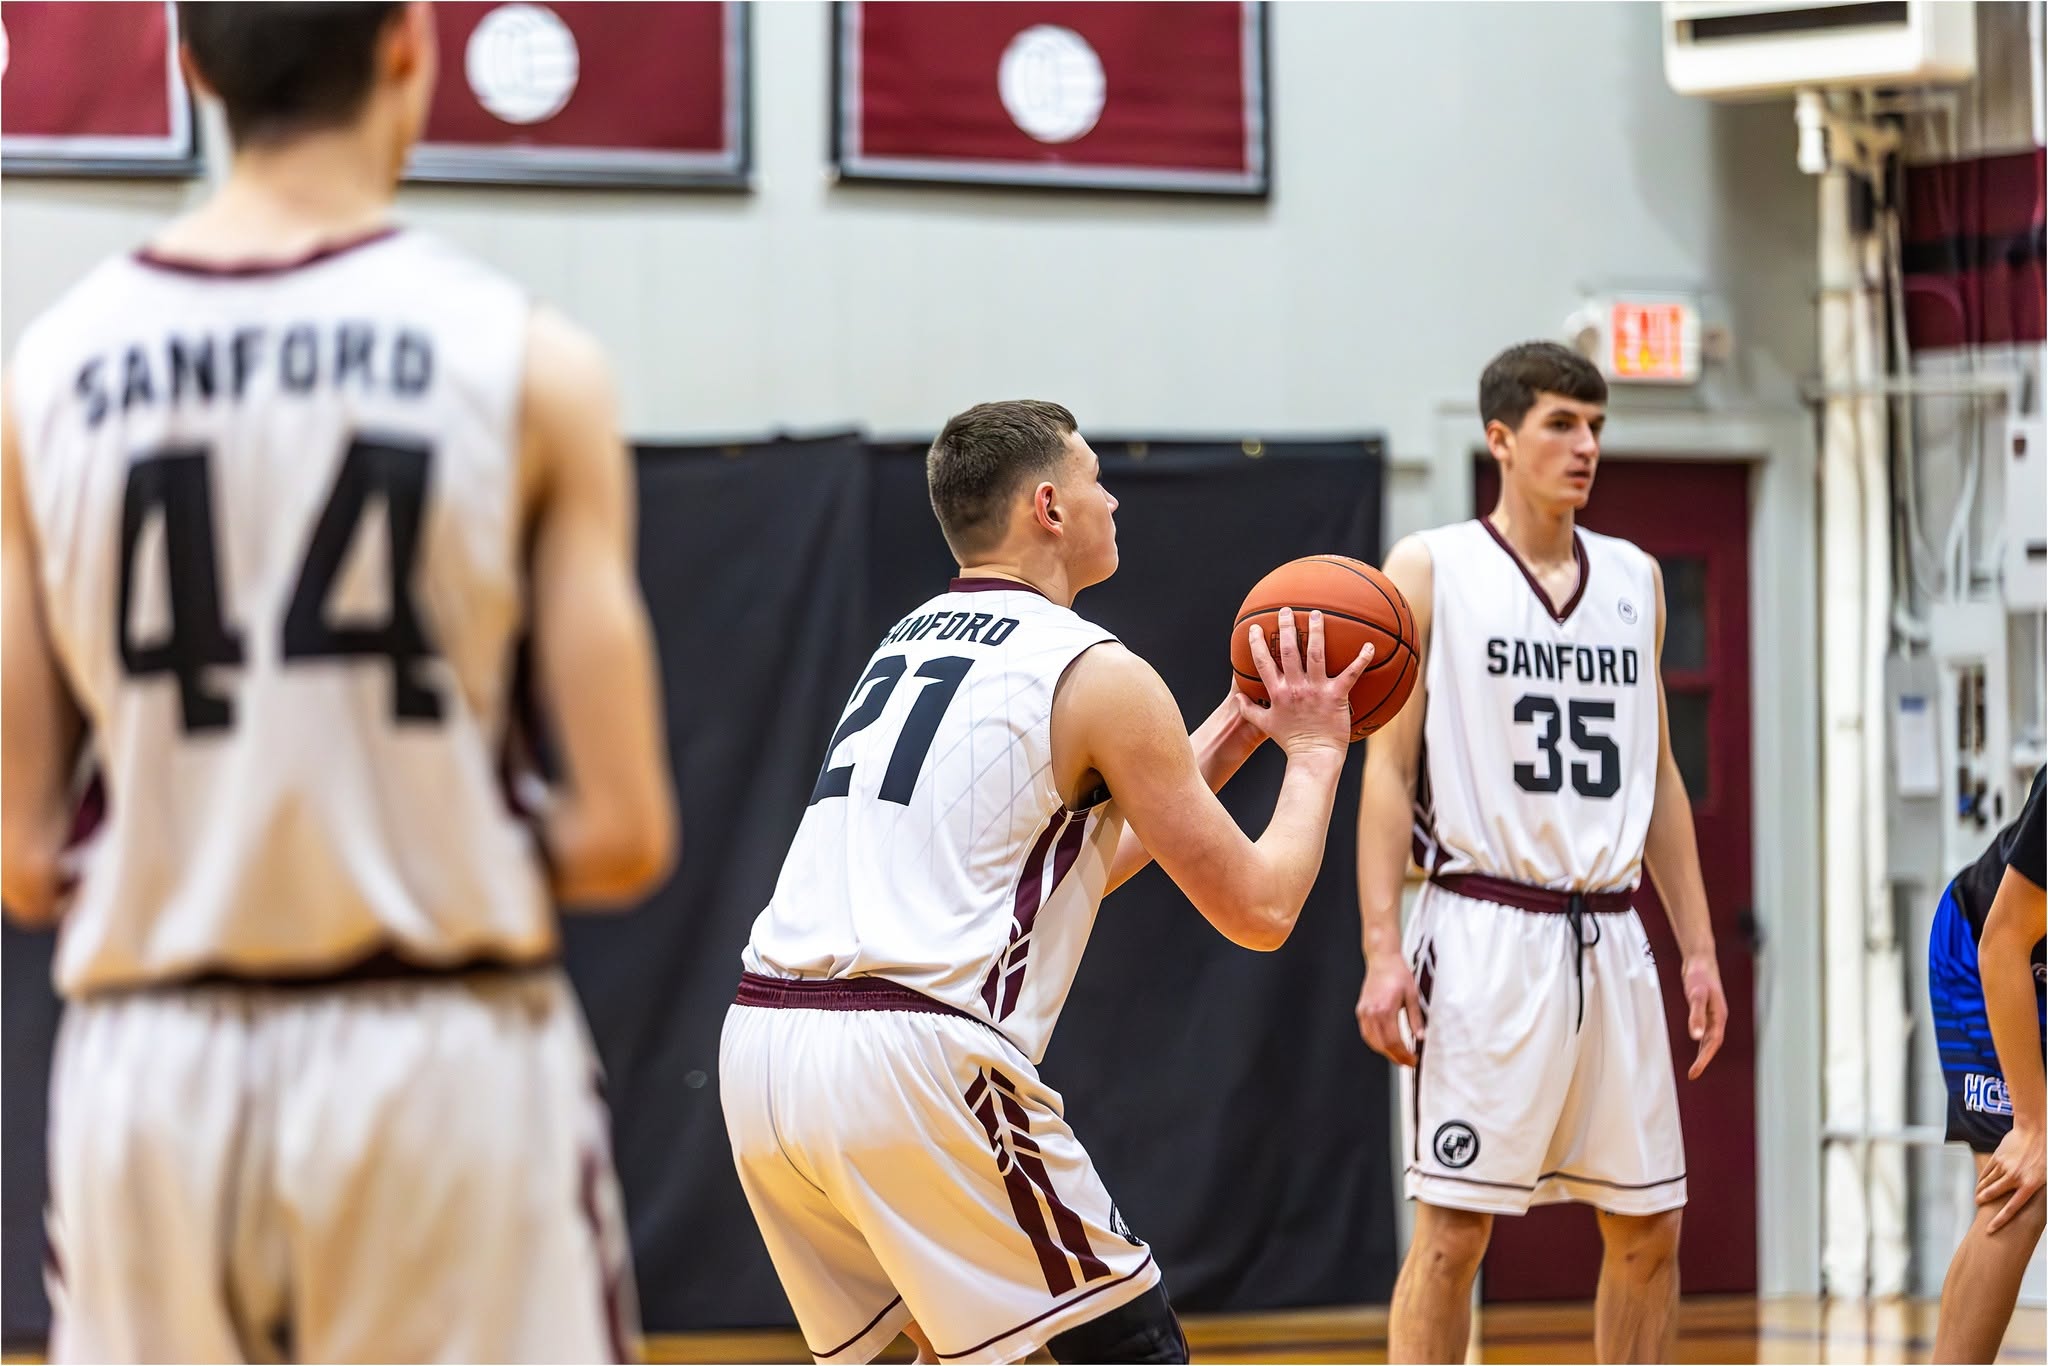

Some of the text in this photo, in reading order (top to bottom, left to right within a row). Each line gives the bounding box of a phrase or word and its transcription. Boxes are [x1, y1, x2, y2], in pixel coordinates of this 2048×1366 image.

[77, 321, 436, 428] SANFORD
[119, 429, 452, 736] 44
[1487, 637, 1638, 685] SANFORD
[808, 654, 975, 806] 21
[1513, 695, 1621, 798] 35
